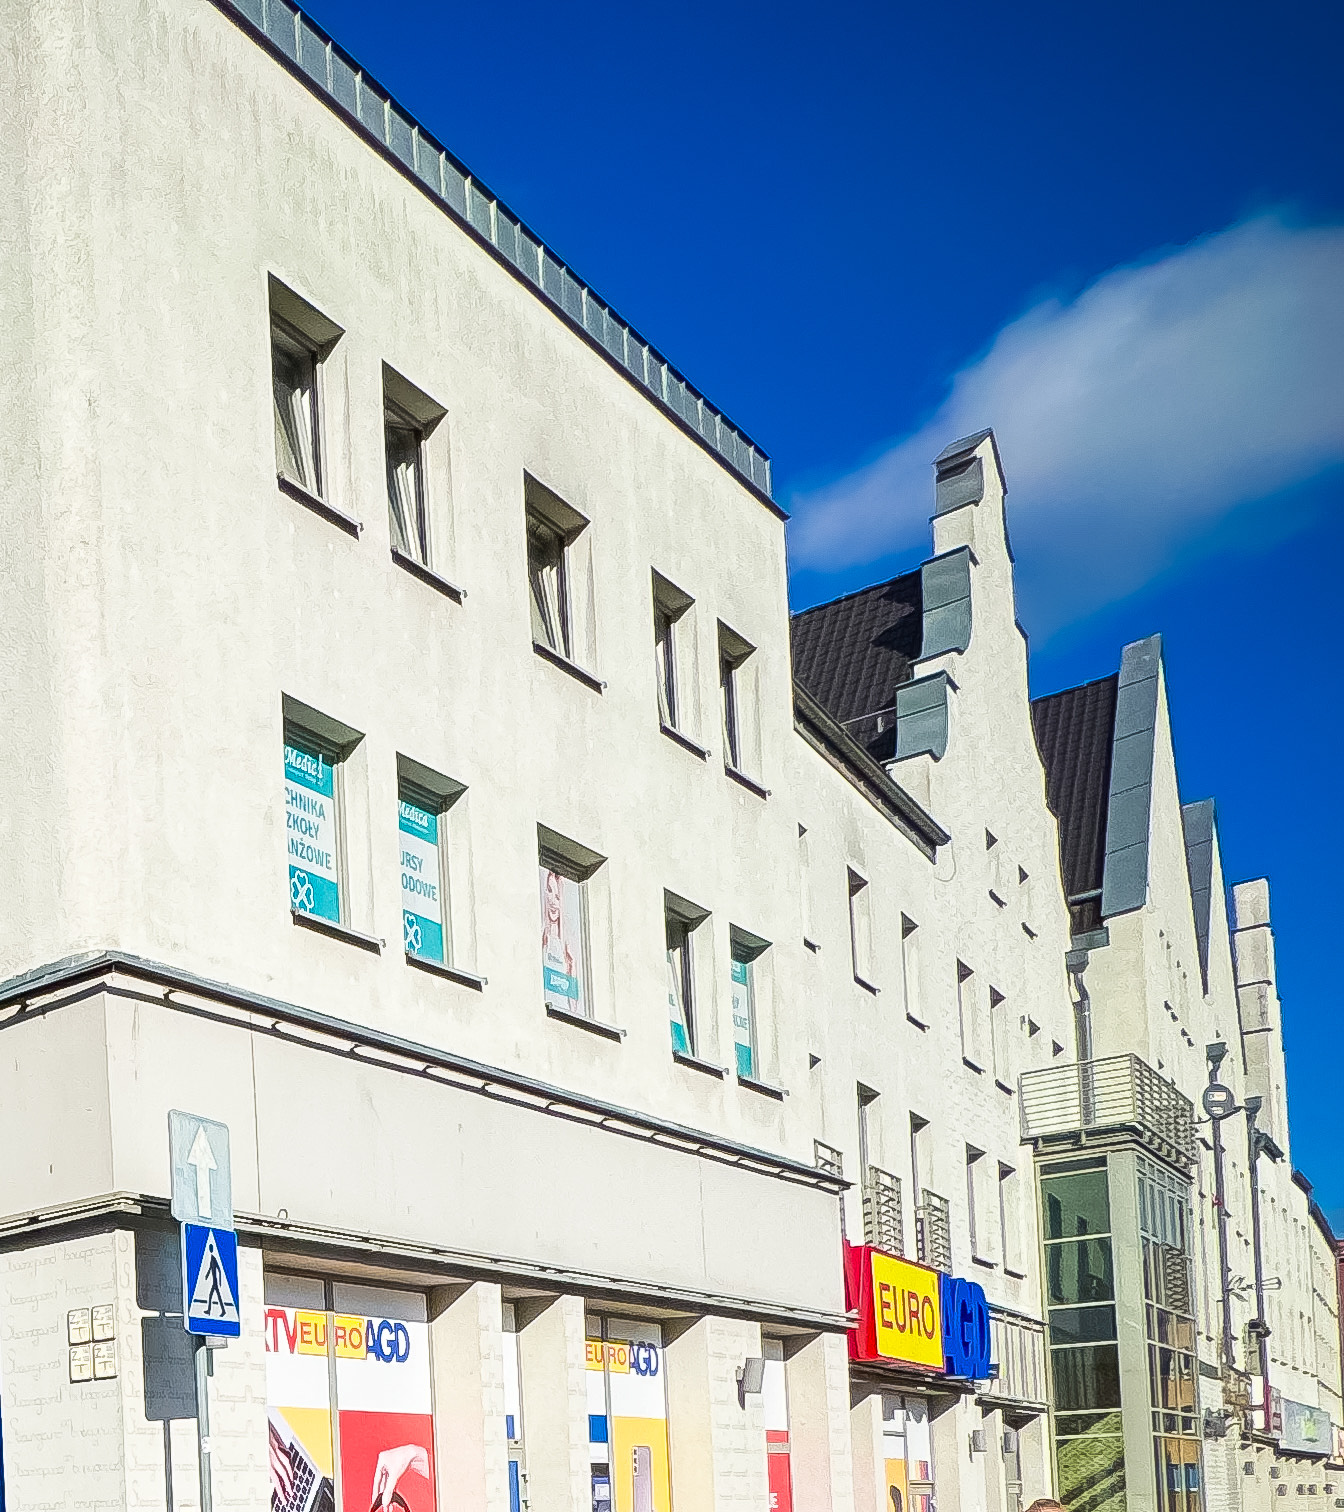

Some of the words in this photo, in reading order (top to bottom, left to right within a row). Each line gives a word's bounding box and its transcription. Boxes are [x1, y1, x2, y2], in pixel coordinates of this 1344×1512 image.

[879, 1282, 935, 1340] EURO
[299, 1321, 362, 1349] EURO
[367, 1320, 410, 1363] AGD
[585, 1343, 627, 1366] EURO
[628, 1341, 658, 1377] AGD
